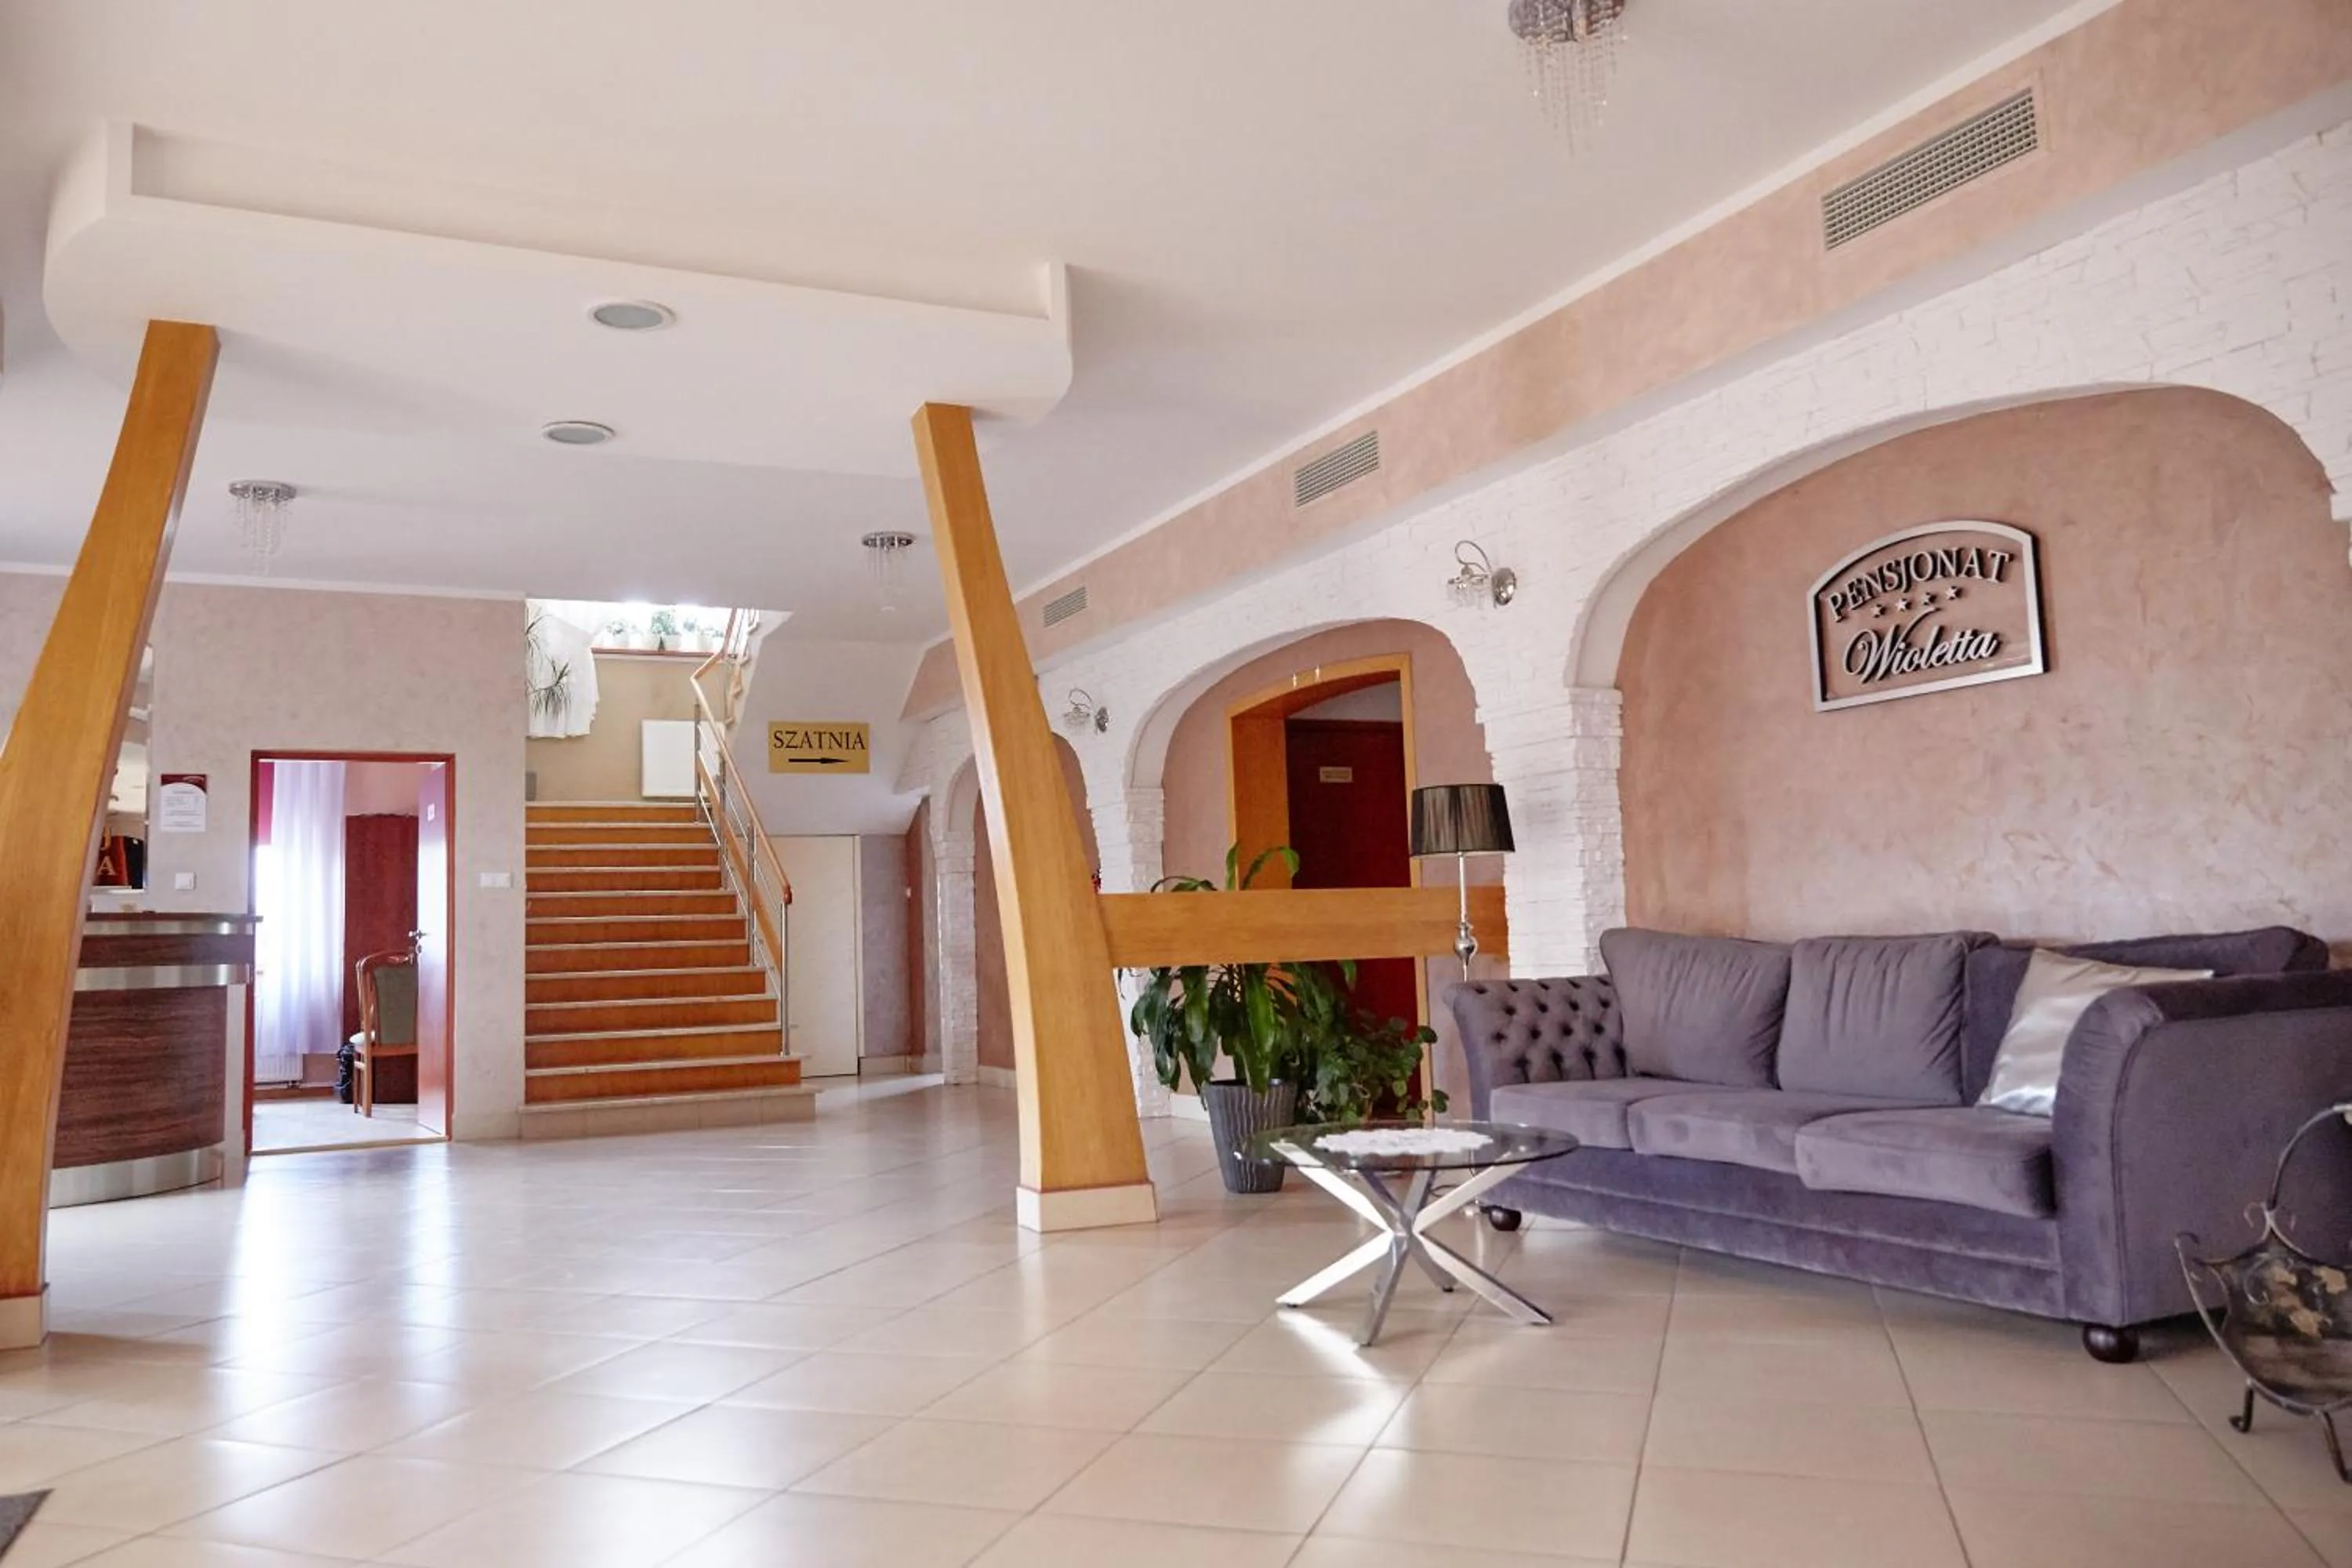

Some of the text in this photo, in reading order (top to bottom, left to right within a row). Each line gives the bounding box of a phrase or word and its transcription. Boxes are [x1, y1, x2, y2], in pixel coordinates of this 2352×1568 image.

[1827, 547, 2013, 622] PENSJONAT
[1844, 607, 2000, 684] Wioletta
[773, 730, 866, 750] SZATNIA
